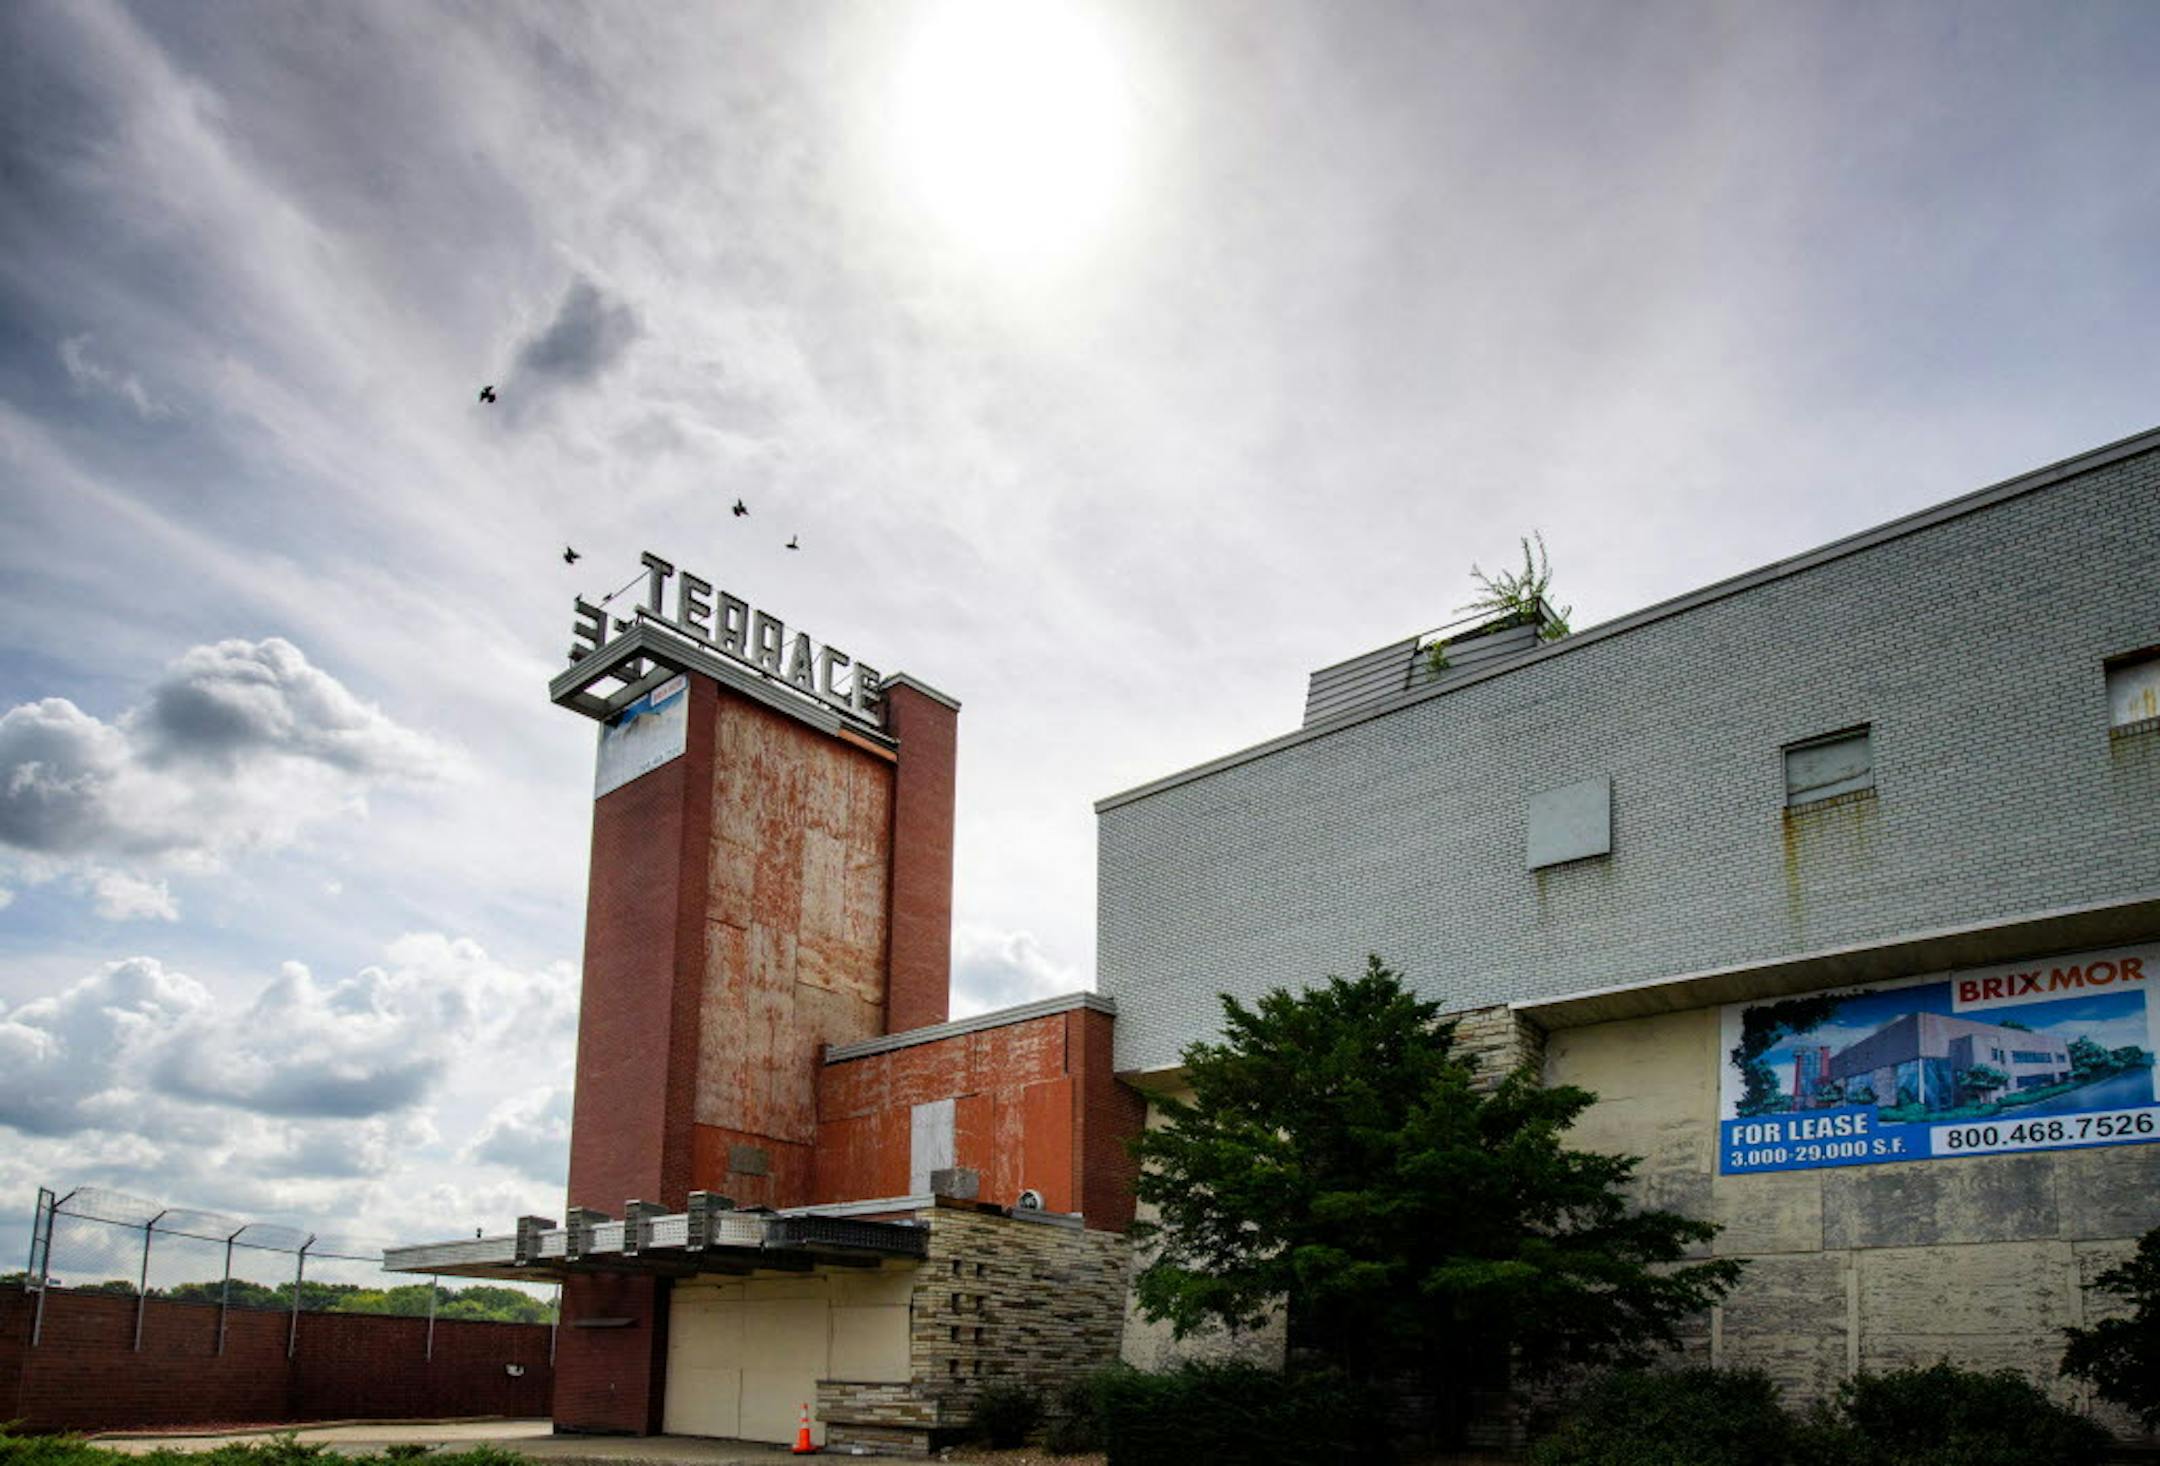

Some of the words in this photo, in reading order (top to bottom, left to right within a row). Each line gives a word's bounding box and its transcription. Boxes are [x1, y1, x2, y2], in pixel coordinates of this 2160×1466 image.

[641, 550, 881, 726] TERRACE
[1959, 957, 2145, 1003] BRIXMOR
[1731, 1124, 1781, 1147] FOR
[1788, 1113, 1868, 1141] LEASE
[1873, 1137, 1906, 1155] S.F.
[1948, 1113, 2154, 1149] 800.468.7526
